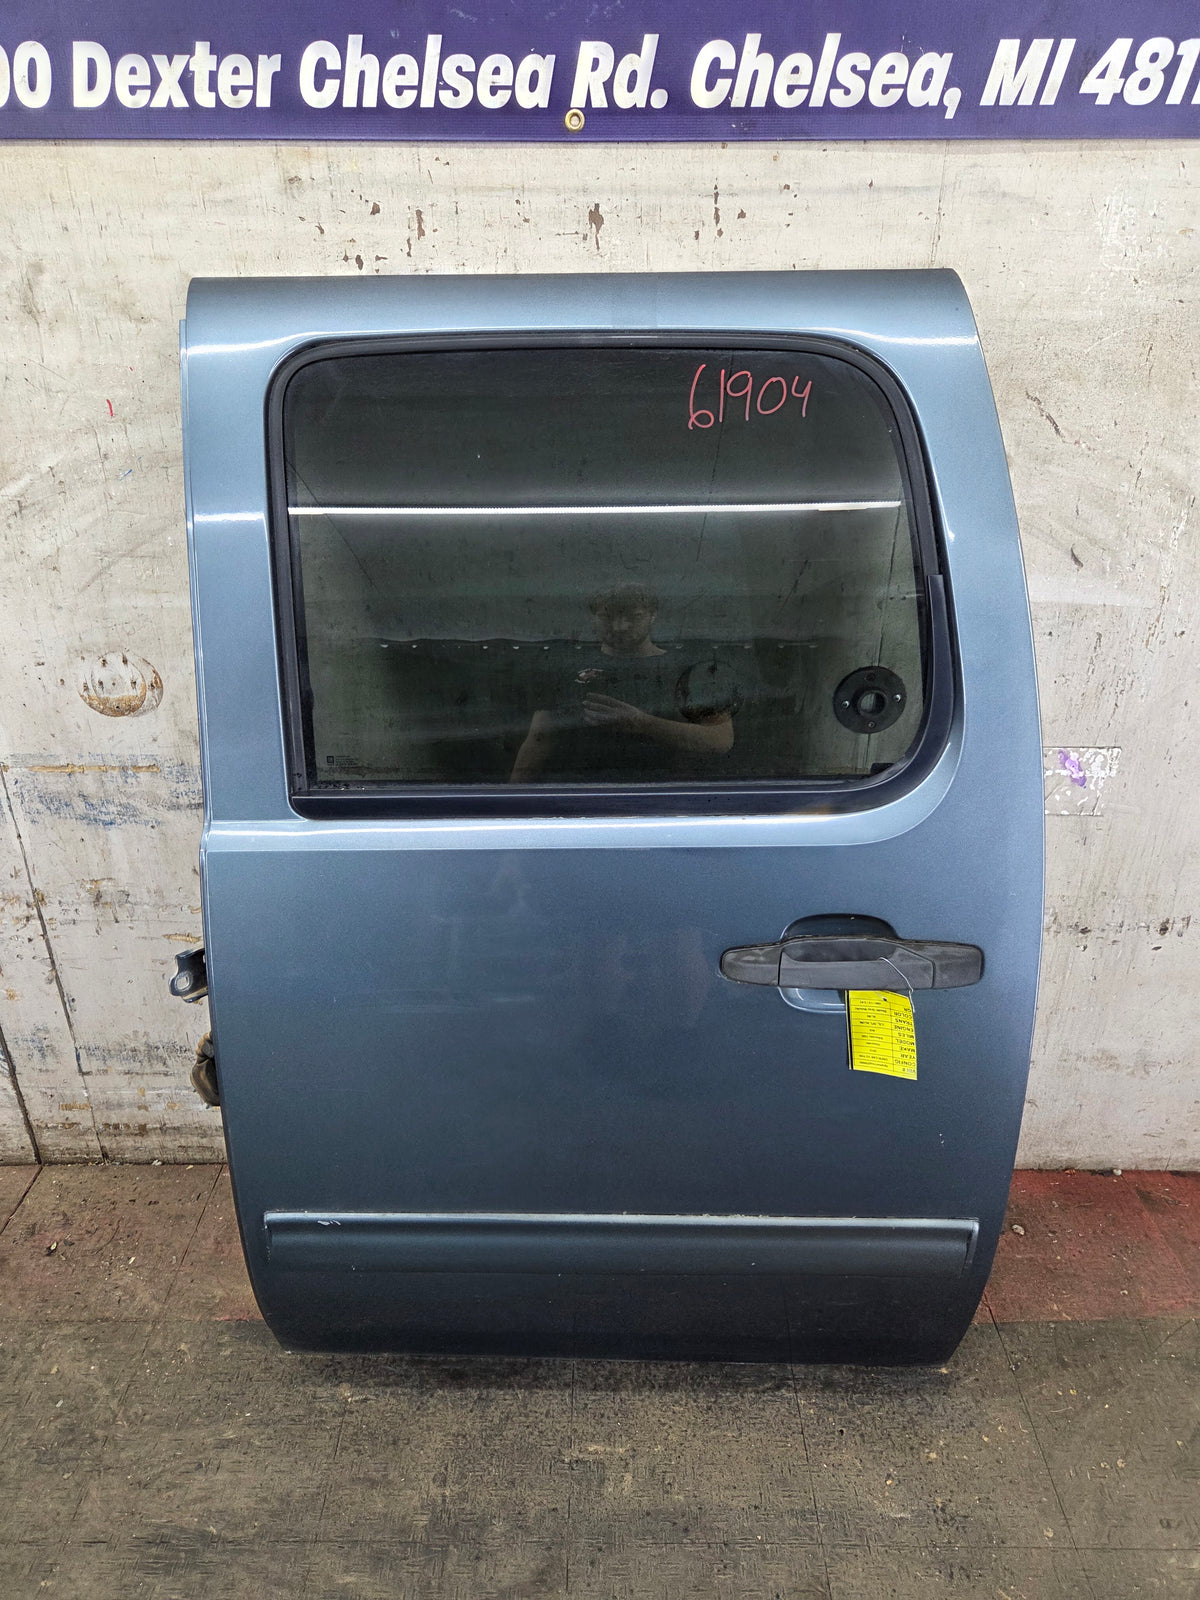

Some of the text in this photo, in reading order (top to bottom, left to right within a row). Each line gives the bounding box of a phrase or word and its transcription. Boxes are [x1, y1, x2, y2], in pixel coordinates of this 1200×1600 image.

[0, 32, 1200, 119] 0 Dexter Chelsea Rd. Chelsea, MI 481
[688, 364, 812, 430] 61904
